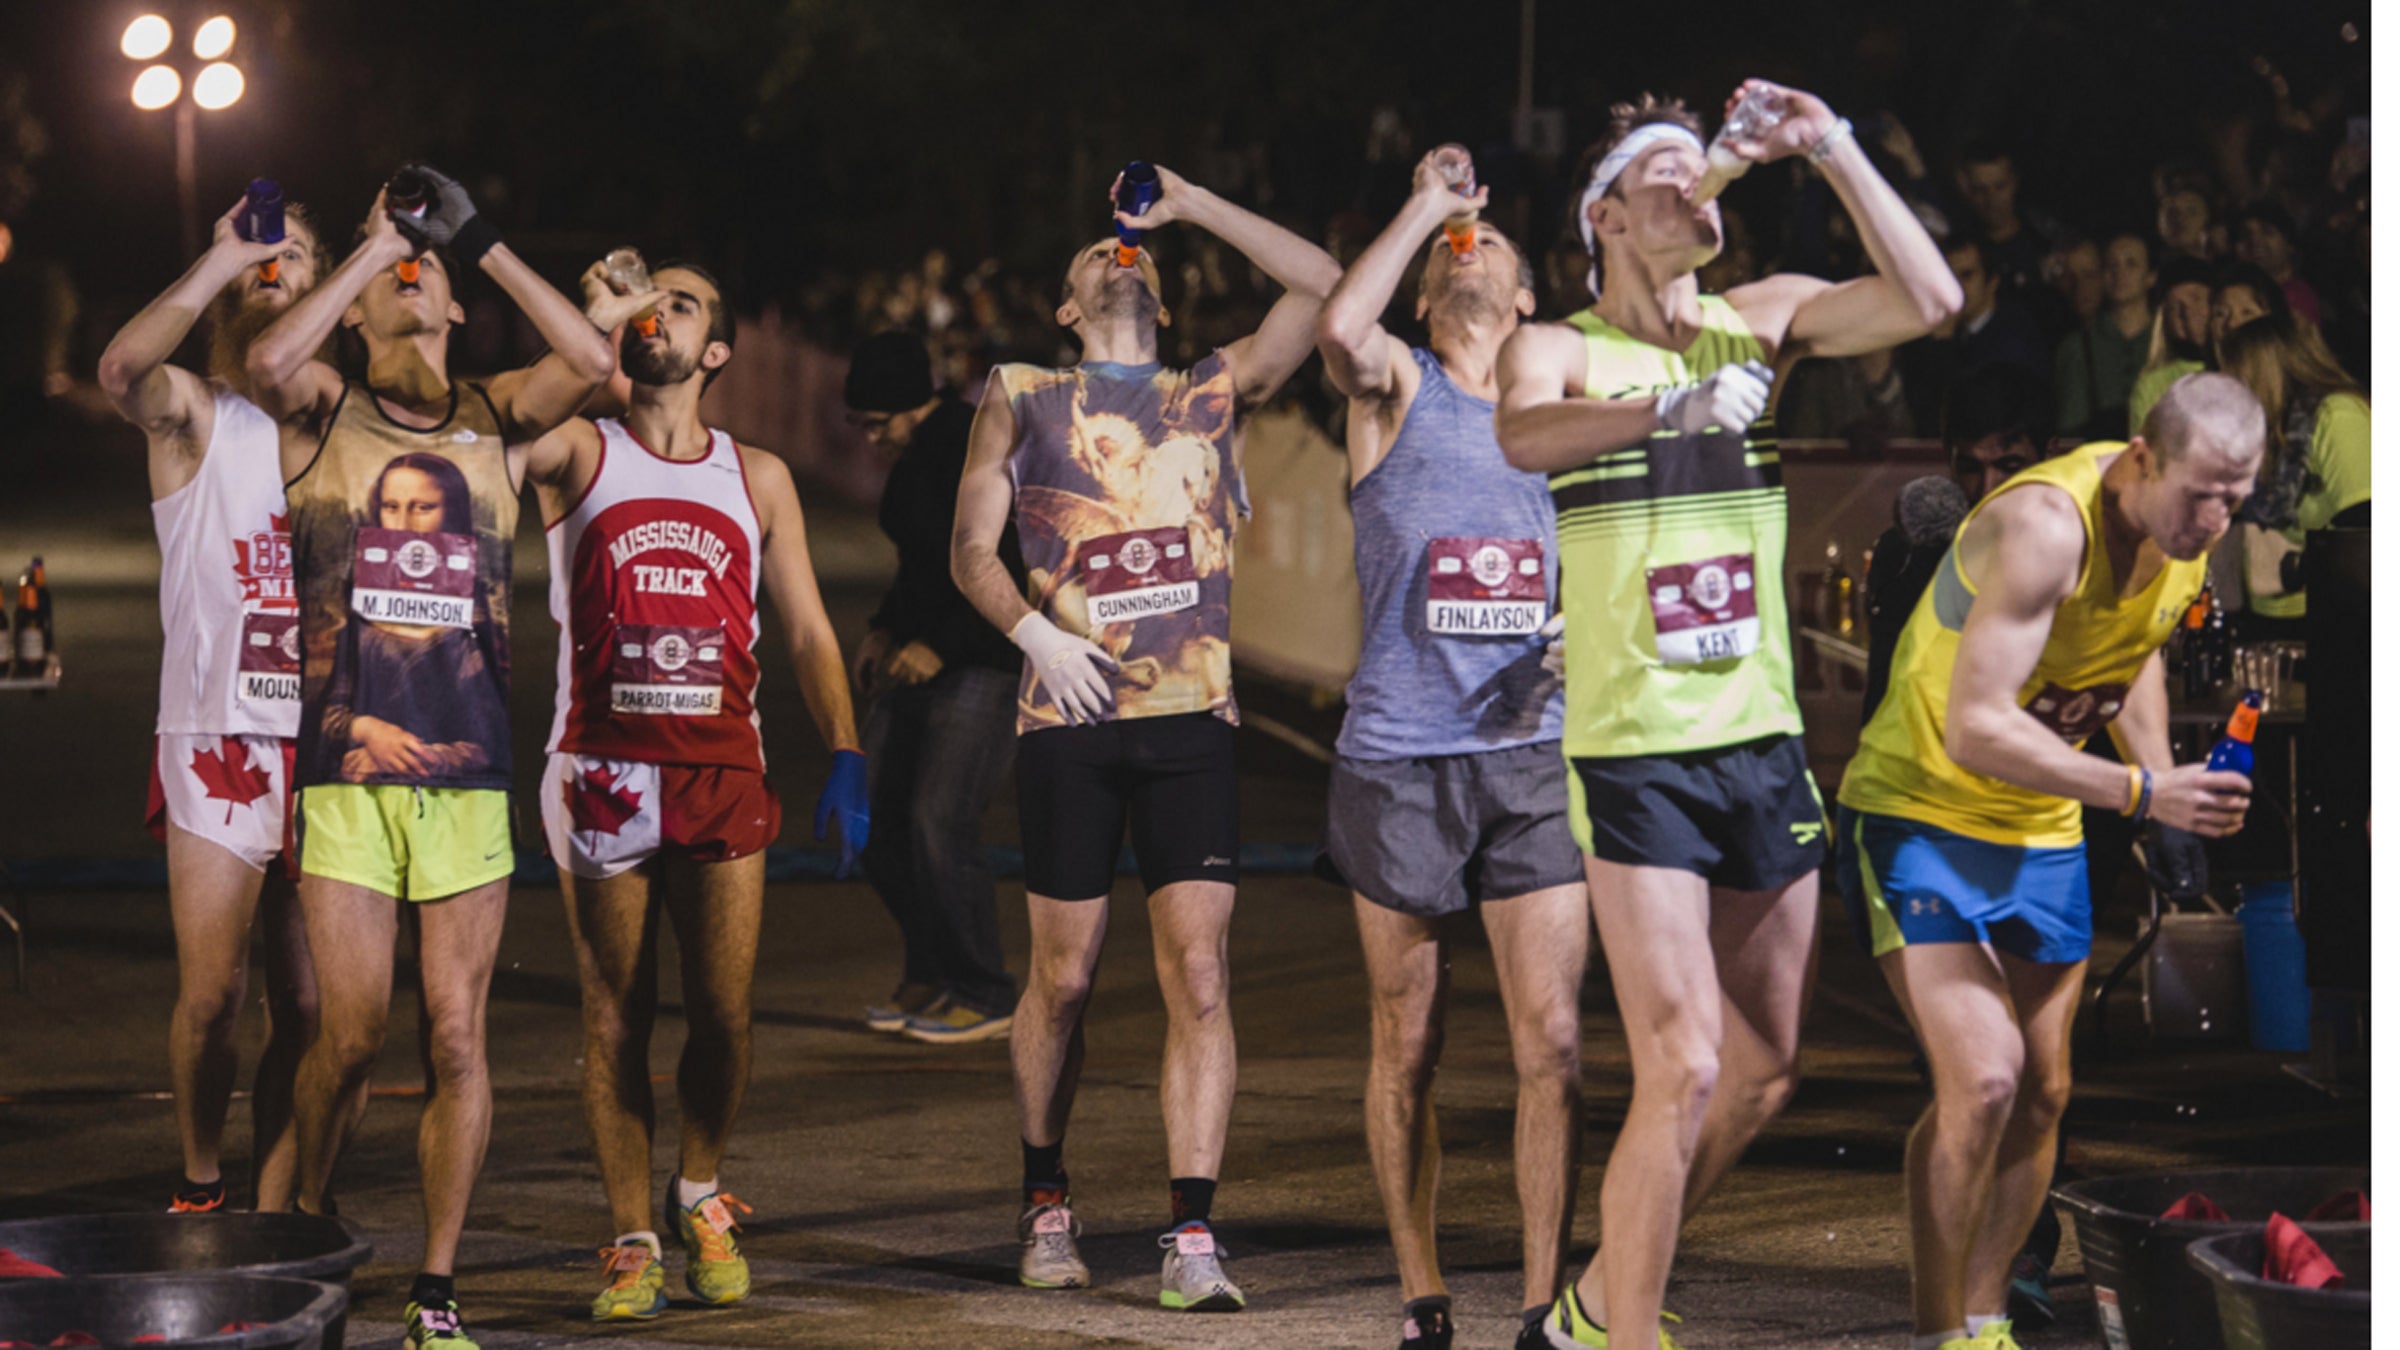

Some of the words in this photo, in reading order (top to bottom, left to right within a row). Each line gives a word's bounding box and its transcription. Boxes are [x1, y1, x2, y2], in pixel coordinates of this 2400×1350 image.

[608, 520, 732, 580] MISSISSAUGA
[633, 564, 708, 597] TRACK
[363, 594, 383, 616] M.
[386, 598, 464, 622] JOHNSON
[1097, 588, 1191, 617] CUNNINGHAM
[1437, 606, 1536, 630] FINLAYSON
[1696, 627, 1740, 658] KENT
